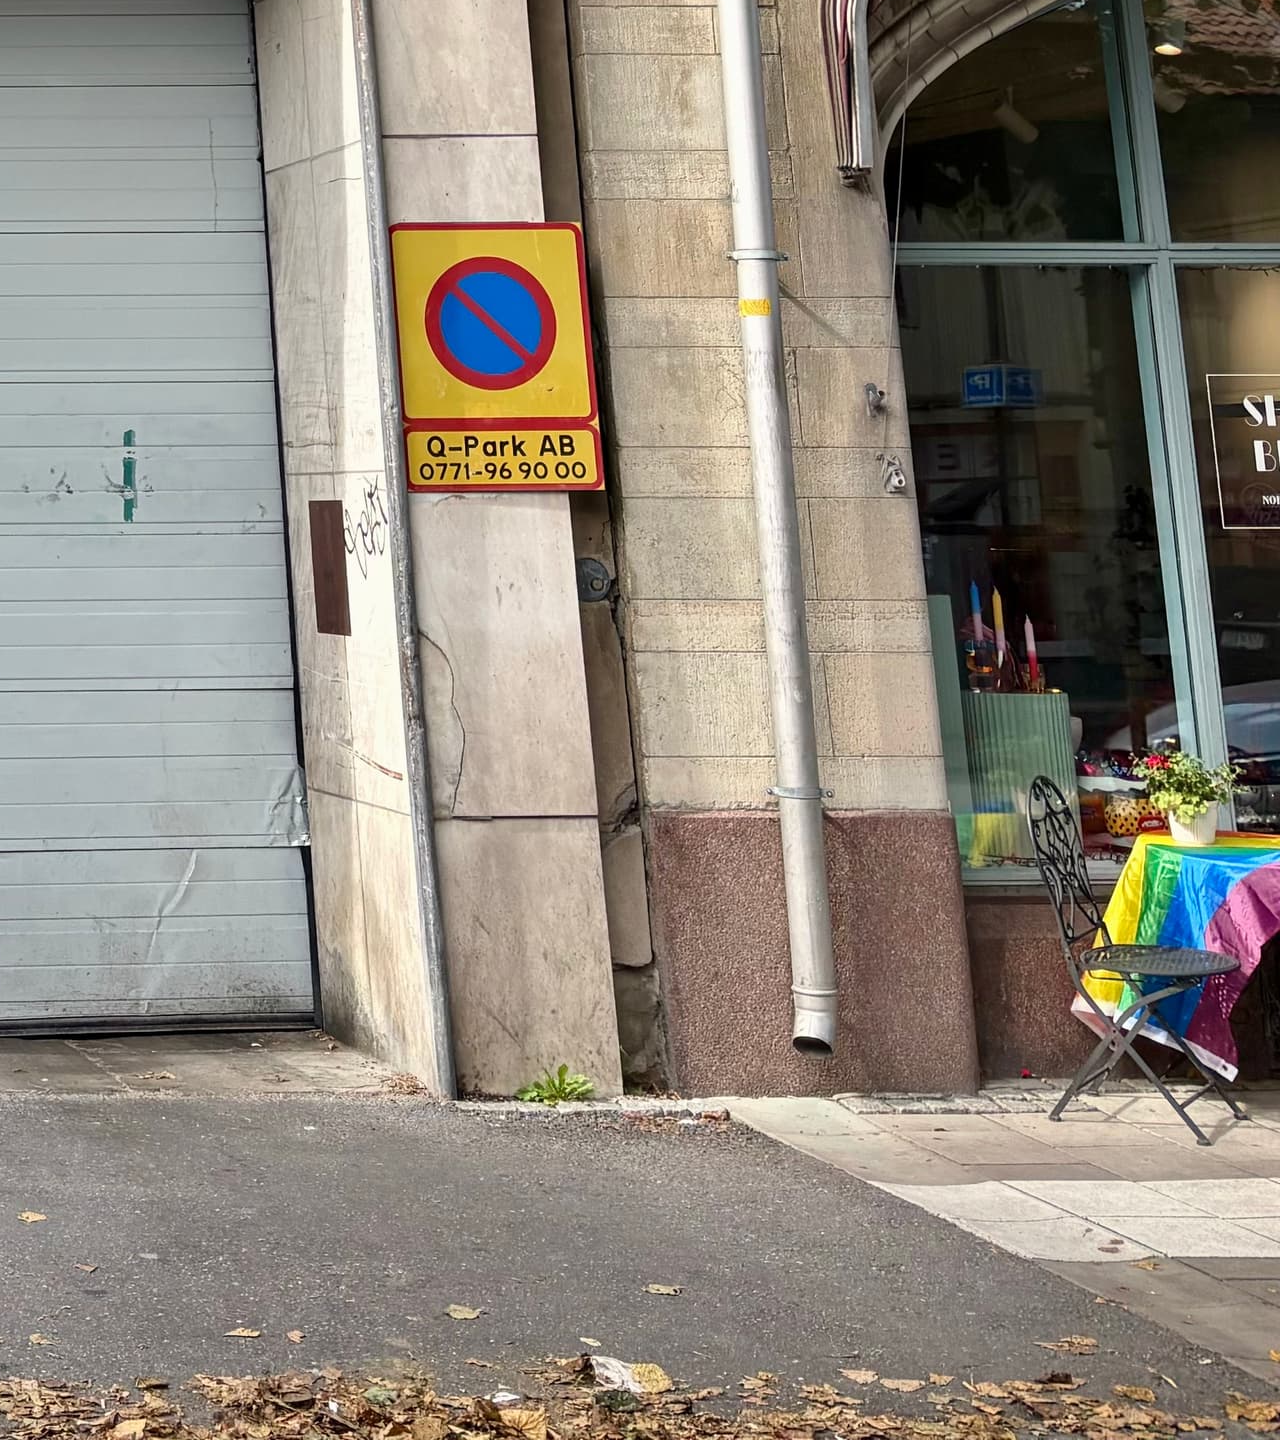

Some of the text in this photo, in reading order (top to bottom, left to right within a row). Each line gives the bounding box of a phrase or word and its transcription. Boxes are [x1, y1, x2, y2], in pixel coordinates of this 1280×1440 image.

[426, 434, 575, 458] Q-Park AB
[1253, 440, 1280, 472] B
[419, 461, 586, 481] 0771-96 90 00
